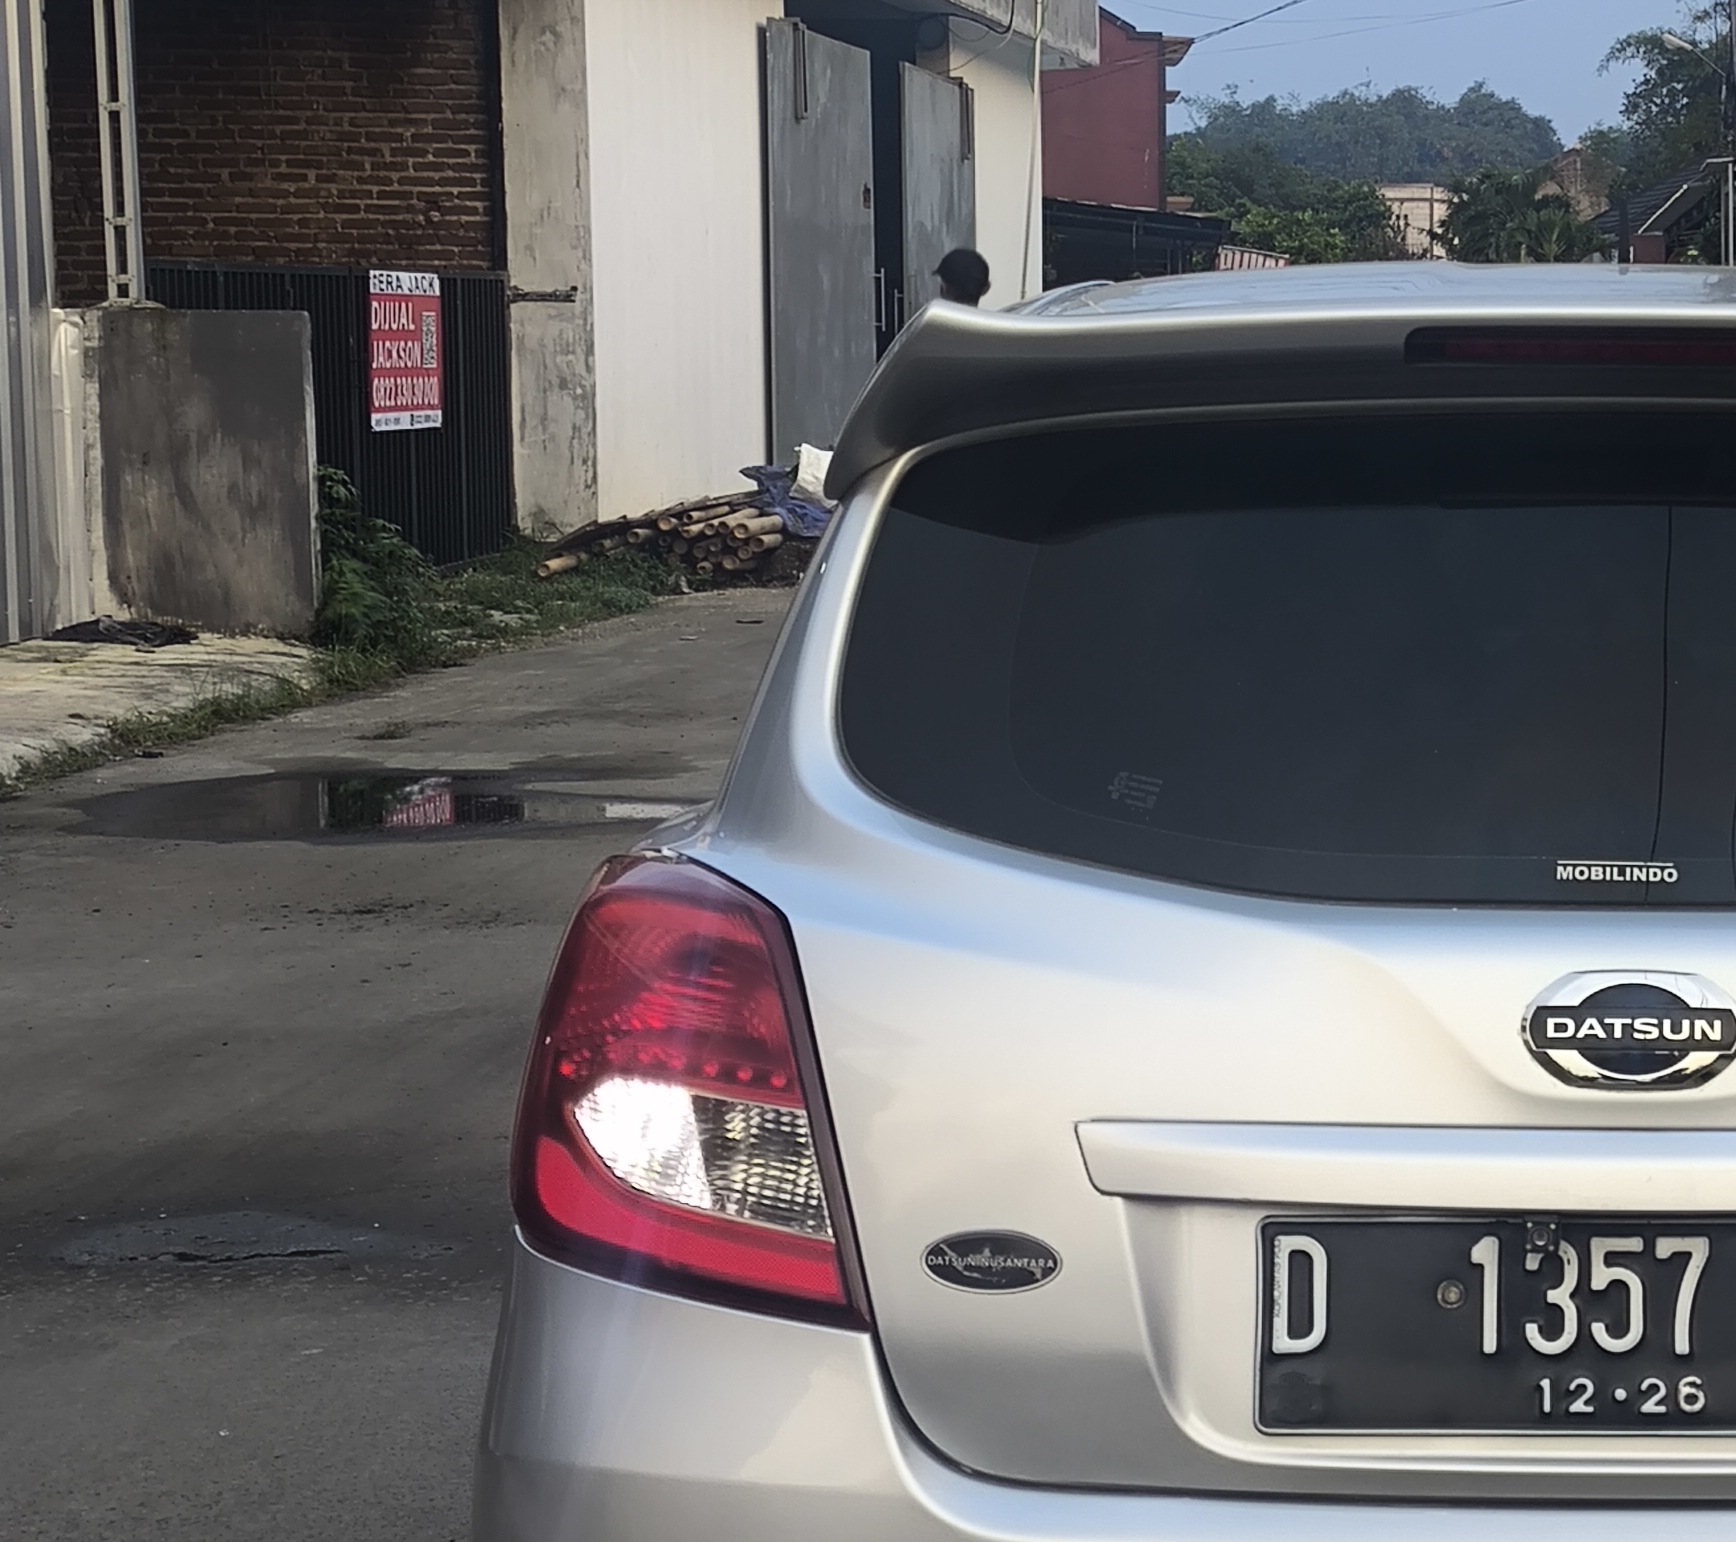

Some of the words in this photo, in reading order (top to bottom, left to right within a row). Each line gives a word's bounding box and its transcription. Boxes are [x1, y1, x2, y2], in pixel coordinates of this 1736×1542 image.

[407, 275, 436, 294] JACK
[371, 301, 415, 331] DIJUAL
[372, 340, 421, 369] JACKSON
[1556, 865, 1678, 883] MOBILINDO
[1546, 1017, 1722, 1041] DATSUN
[927, 1255, 975, 1267] DATSUN
[981, 1256, 1055, 1269] NUSANTARA
[1272, 1235, 1327, 1354] D
[1470, 1236, 1710, 1355] 1357
